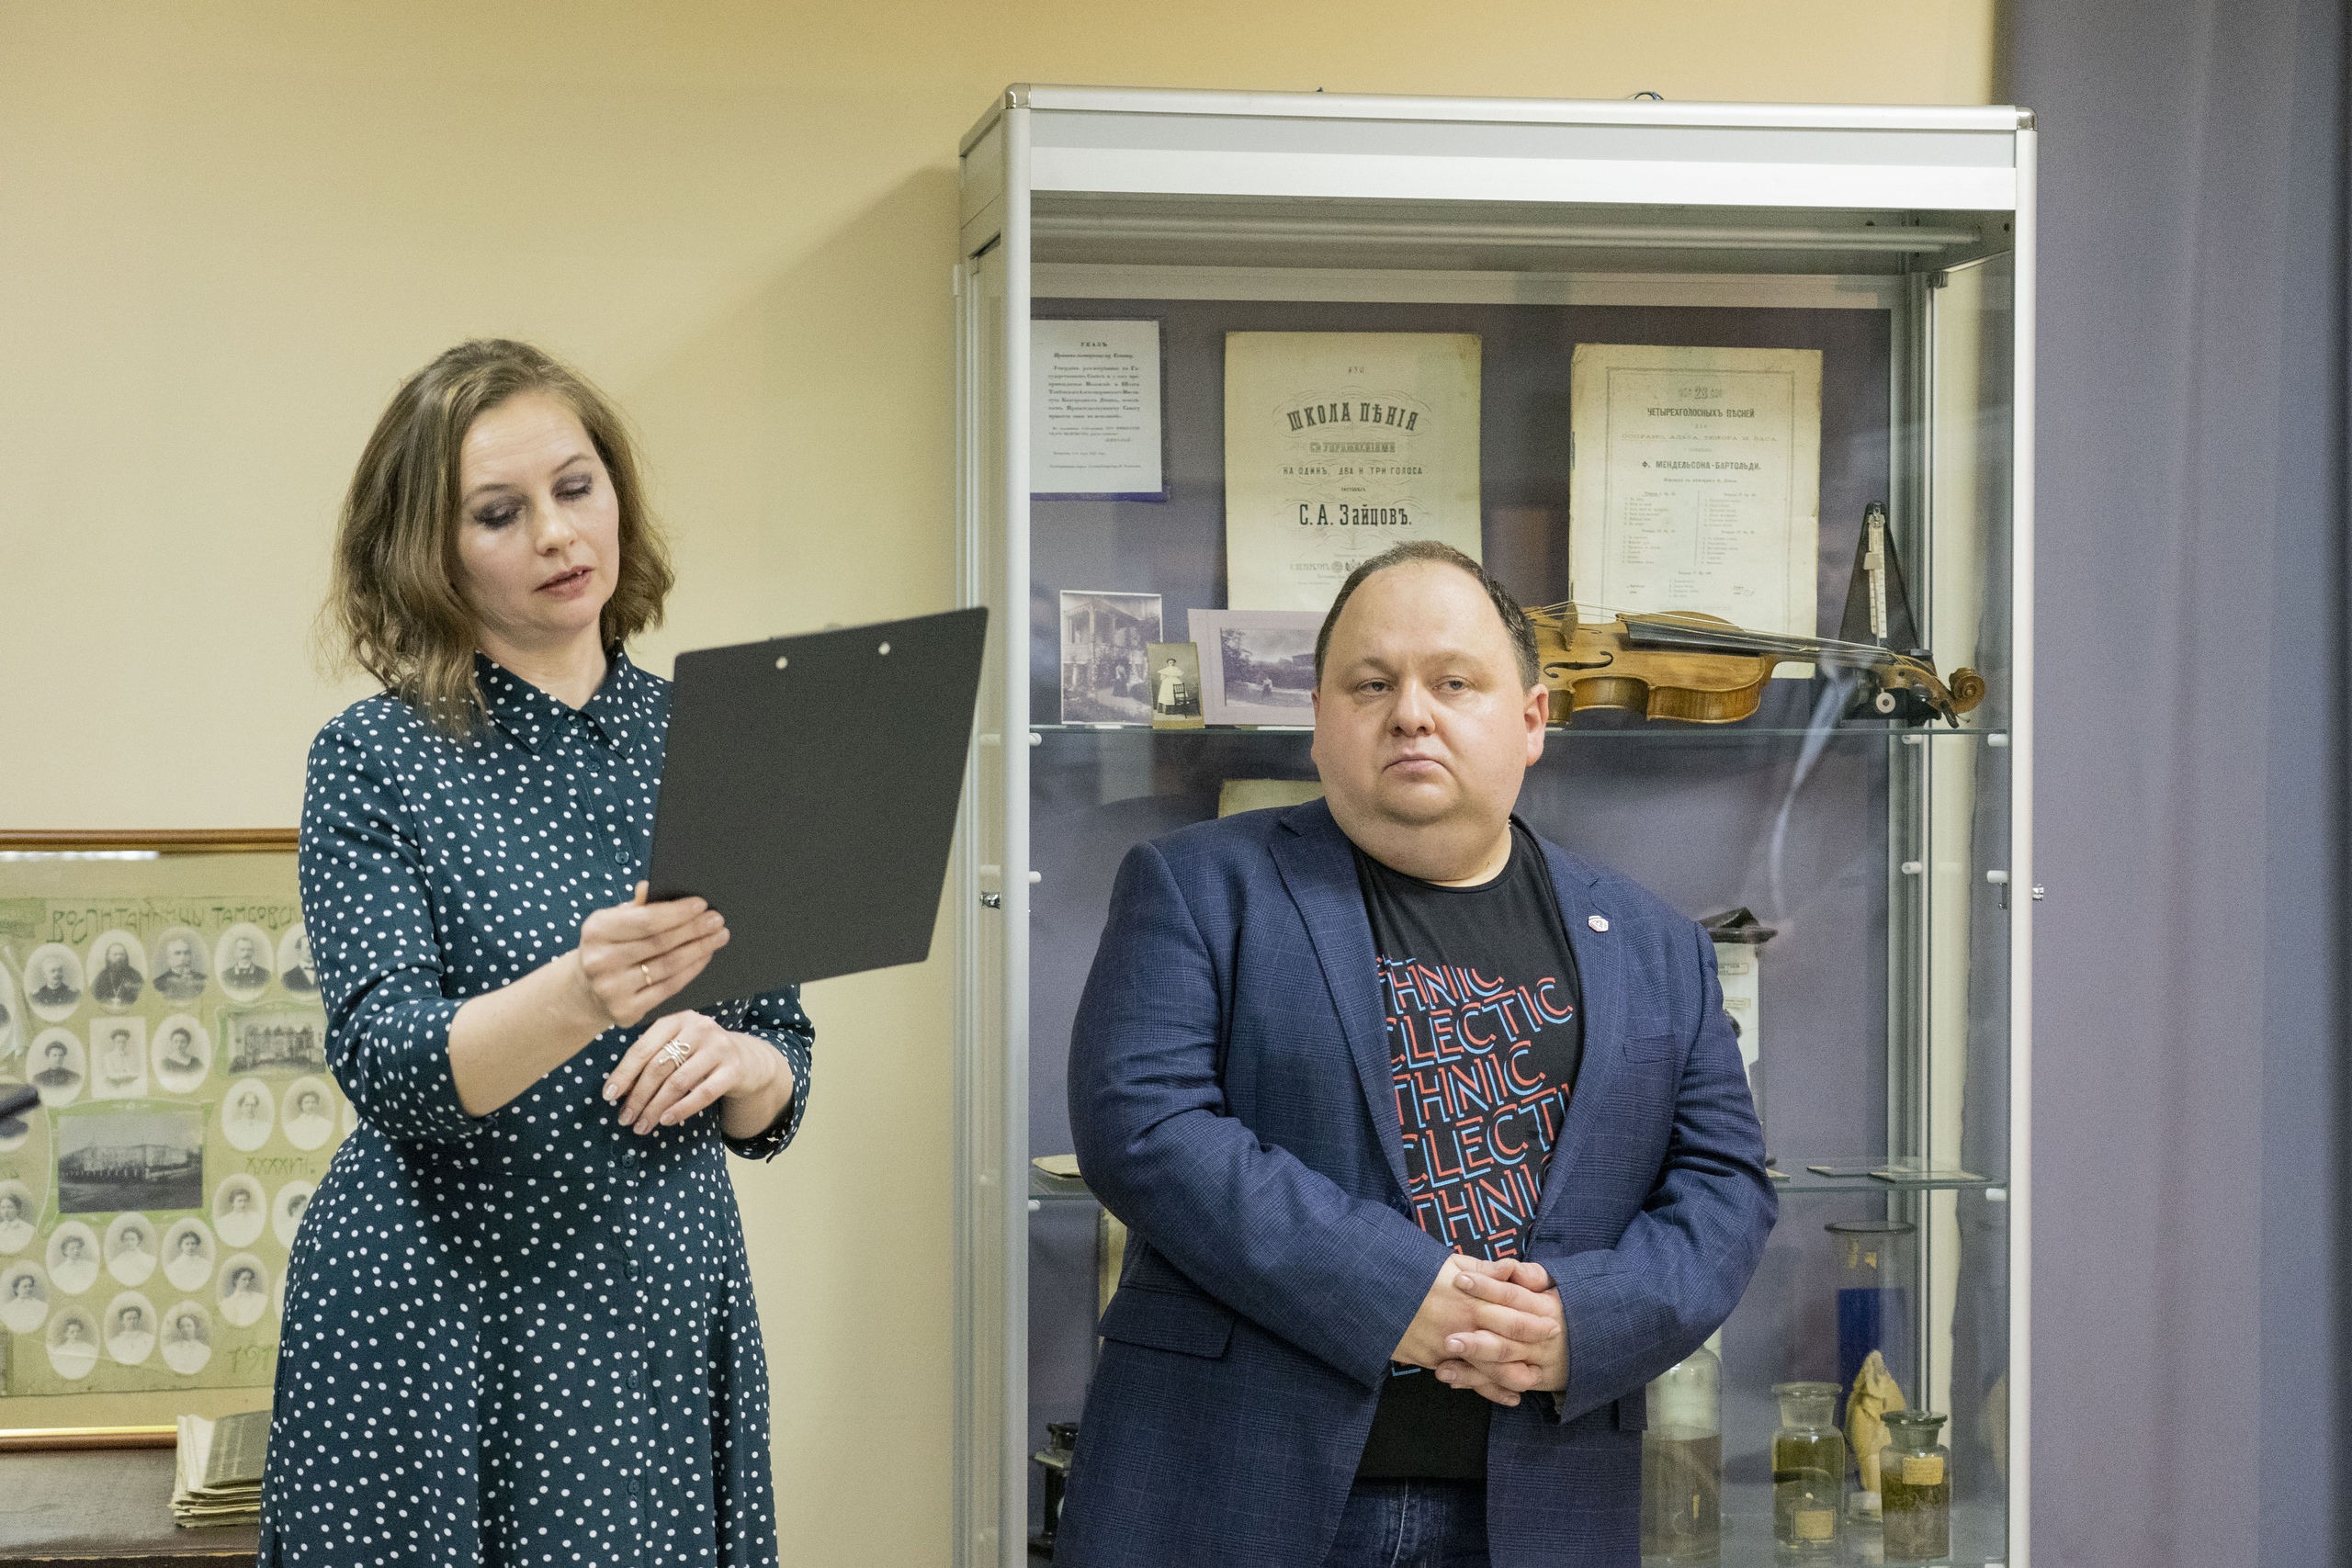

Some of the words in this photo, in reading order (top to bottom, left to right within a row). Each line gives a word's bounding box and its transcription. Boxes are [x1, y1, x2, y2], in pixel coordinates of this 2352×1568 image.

[1287, 402, 1351, 432] ШКОЛА
[1647, 407, 1723, 418] ЧЕТЫРЕХГОЛОСНЫХЪ
[1283, 467, 1294, 475] НА
[1339, 467, 1353, 476] ДВА
[1371, 467, 1386, 475] ТРИ
[1390, 467, 1423, 475] ГОЛОСА
[1300, 504, 1313, 525] С.
[1317, 504, 1333, 525] А.
[1340, 504, 1411, 526] Зайцовъ.
